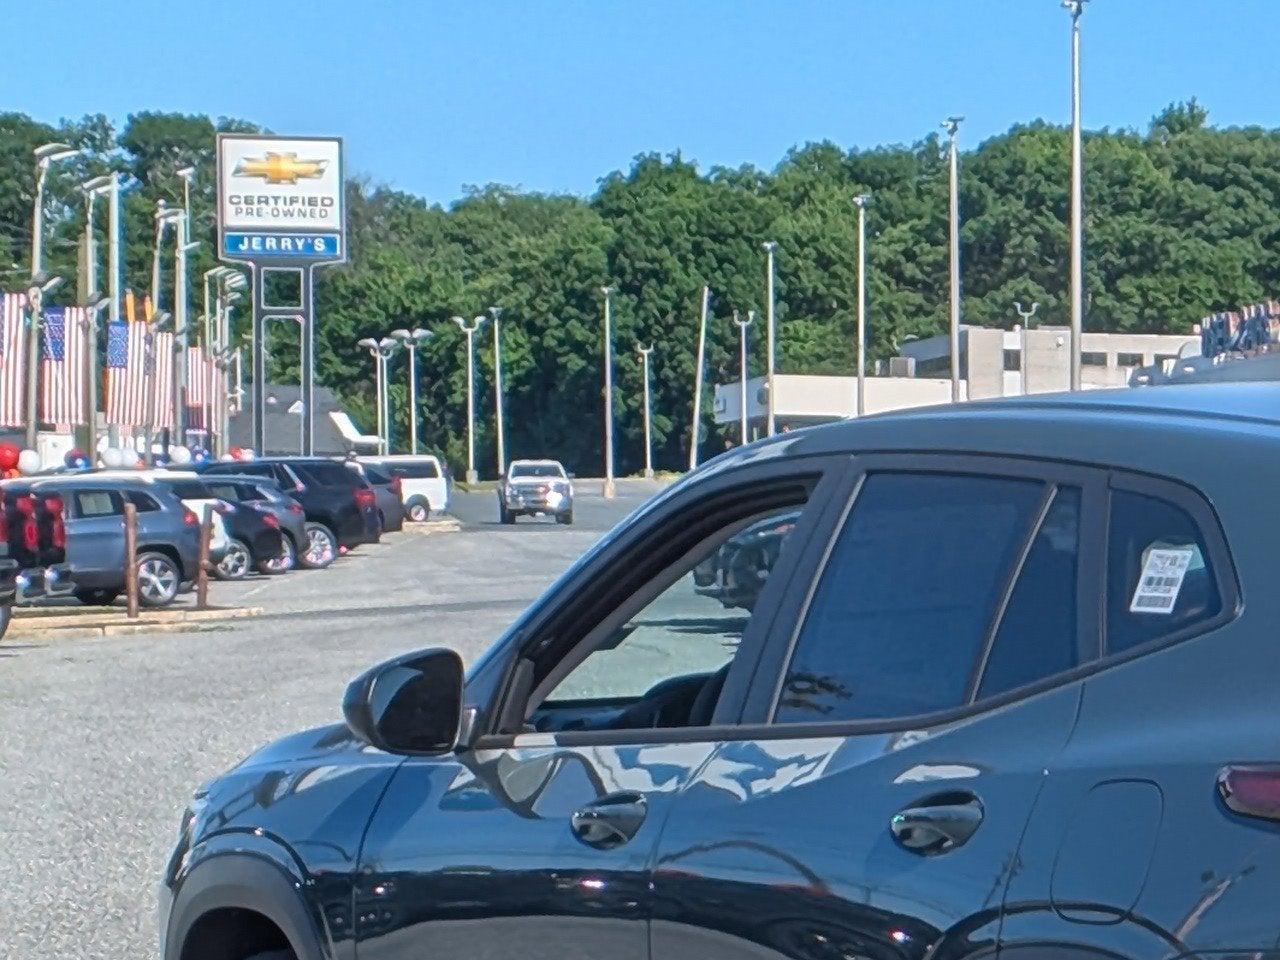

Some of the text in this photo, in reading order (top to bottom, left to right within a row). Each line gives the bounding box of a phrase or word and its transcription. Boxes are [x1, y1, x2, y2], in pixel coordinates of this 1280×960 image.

[228, 195, 334, 207] CERTIFIED
[235, 207, 328, 218] PRE-OWNED
[239, 236, 325, 251] JERRY'S
